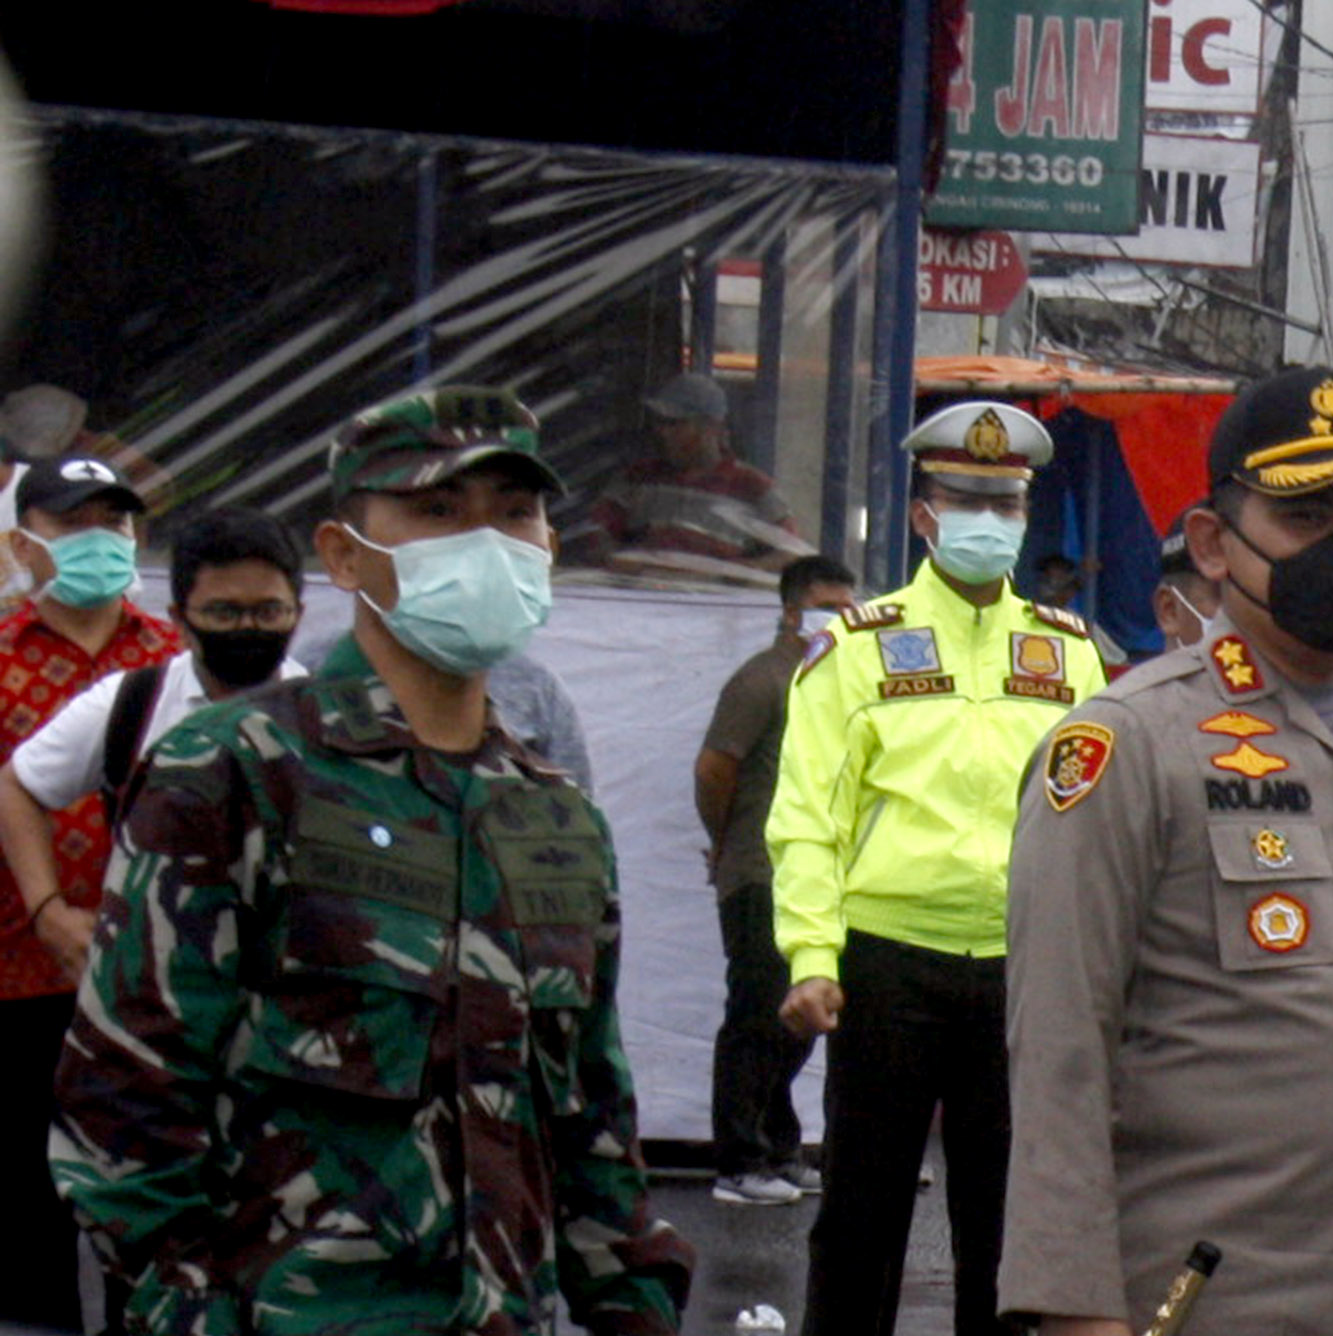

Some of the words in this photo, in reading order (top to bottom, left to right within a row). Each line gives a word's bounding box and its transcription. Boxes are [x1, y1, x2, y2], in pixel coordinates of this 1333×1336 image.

[994, 13, 1123, 141] JAM
[942, 150, 1104, 187] 753360
[1140, 168, 1228, 232] NIK
[942, 272, 982, 306] KM
[1204, 779, 1312, 814] ROLAND
